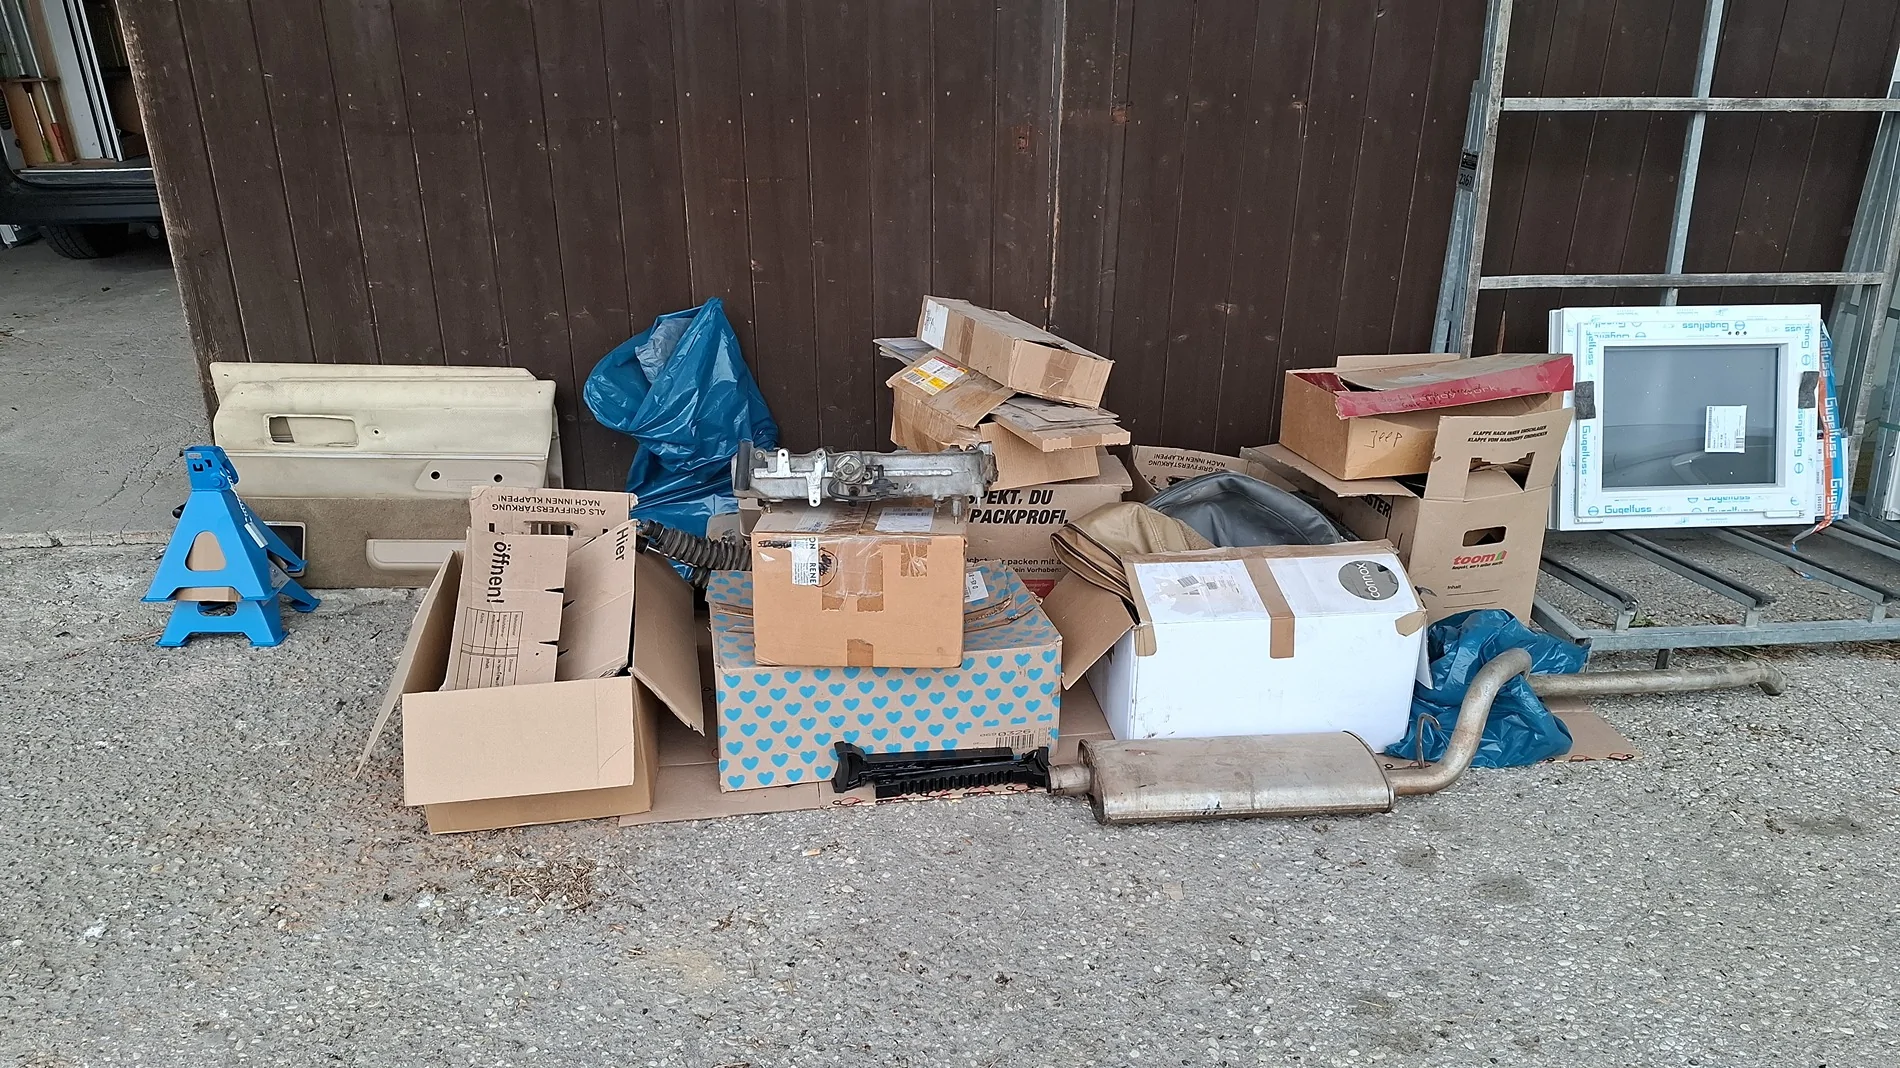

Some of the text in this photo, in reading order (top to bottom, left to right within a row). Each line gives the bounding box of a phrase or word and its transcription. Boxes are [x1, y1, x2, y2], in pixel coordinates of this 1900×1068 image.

[1823, 397, 1841, 459] Gugelfuss
[1153, 453, 1226, 468] NACH INNEN KLAPPEN!
[498, 495, 600, 507] NACH INNEN KLAPPEN!
[1028, 489, 1053, 505] DU
[492, 503, 607, 516] ALS GRIFFVERSTÄRKUNG
[1604, 504, 1652, 515] Gugelfuss
[615, 526, 629, 561] Hier
[1007, 558, 1038, 566] packen
[1453, 553, 1496, 566] toom
[486, 541, 512, 604] öffnen!
[809, 562, 817, 584] RENE
[1356, 562, 1381, 599] connox
